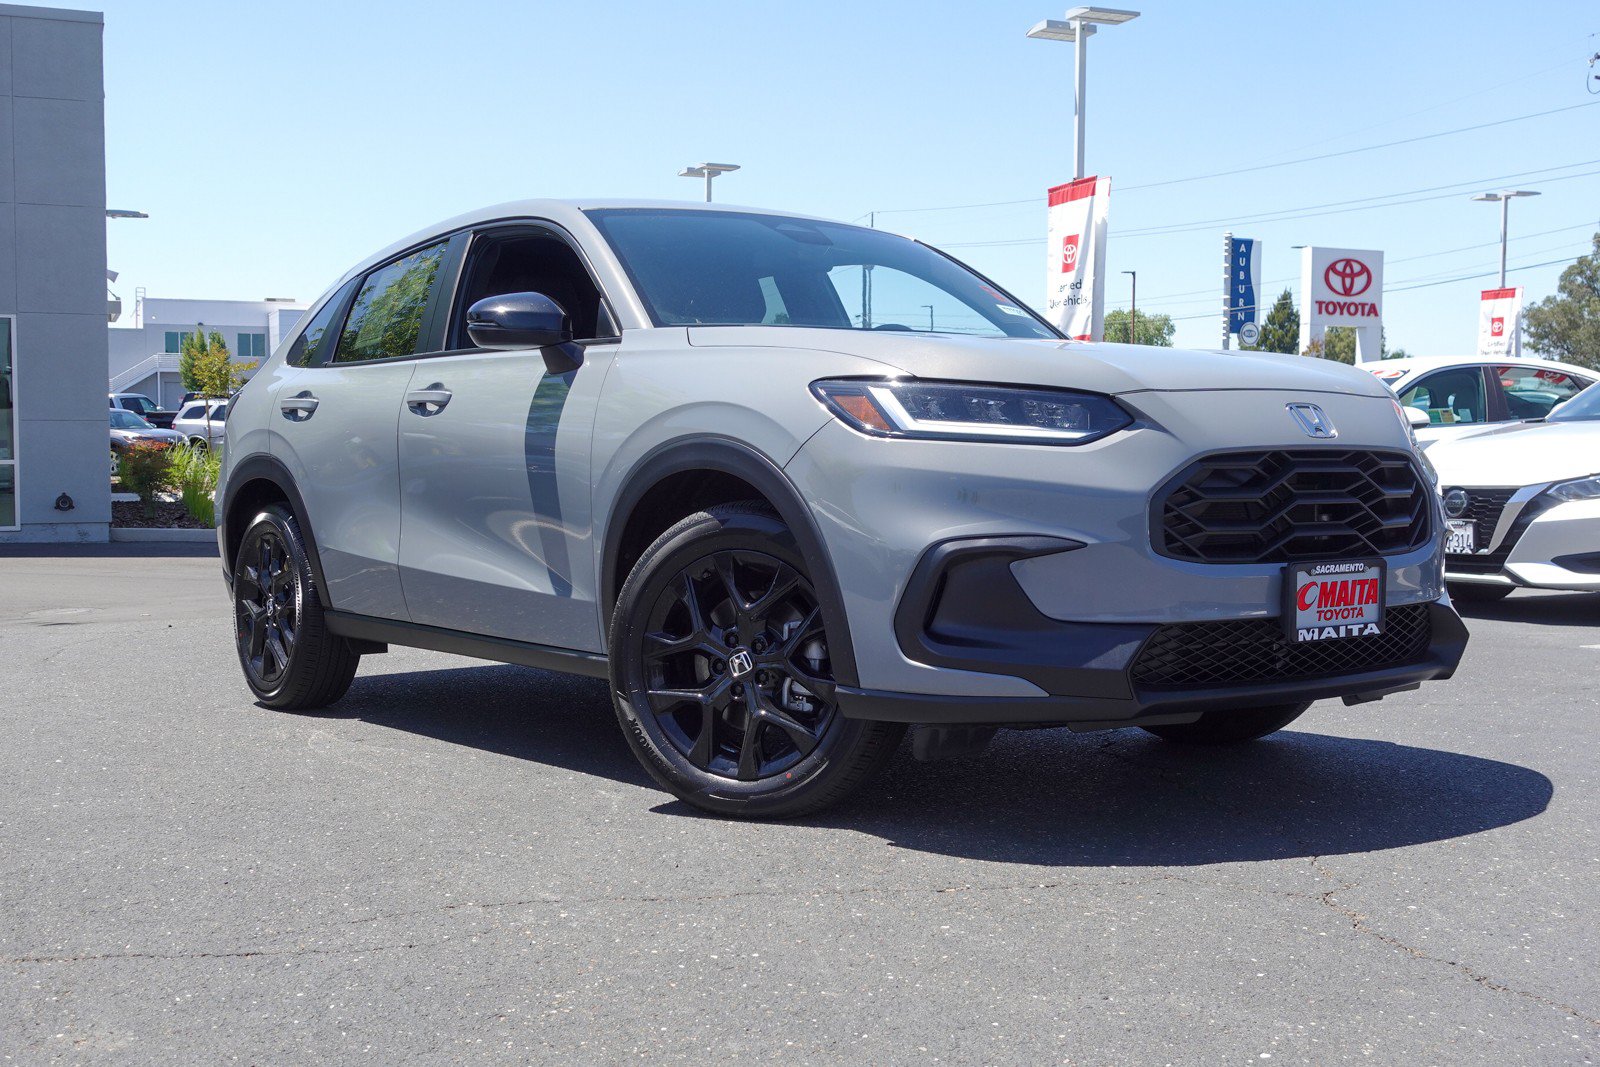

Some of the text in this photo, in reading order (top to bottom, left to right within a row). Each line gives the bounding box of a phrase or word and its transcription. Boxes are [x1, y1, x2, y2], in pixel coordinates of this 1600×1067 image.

[1237, 243, 1247, 321] AUBURN
[1315, 300, 1379, 317] TOYOTA
[1315, 563, 1364, 574] SACRAMENTO
[1316, 606, 1364, 622] TOYOTA
[1298, 622, 1381, 642] MAITA
